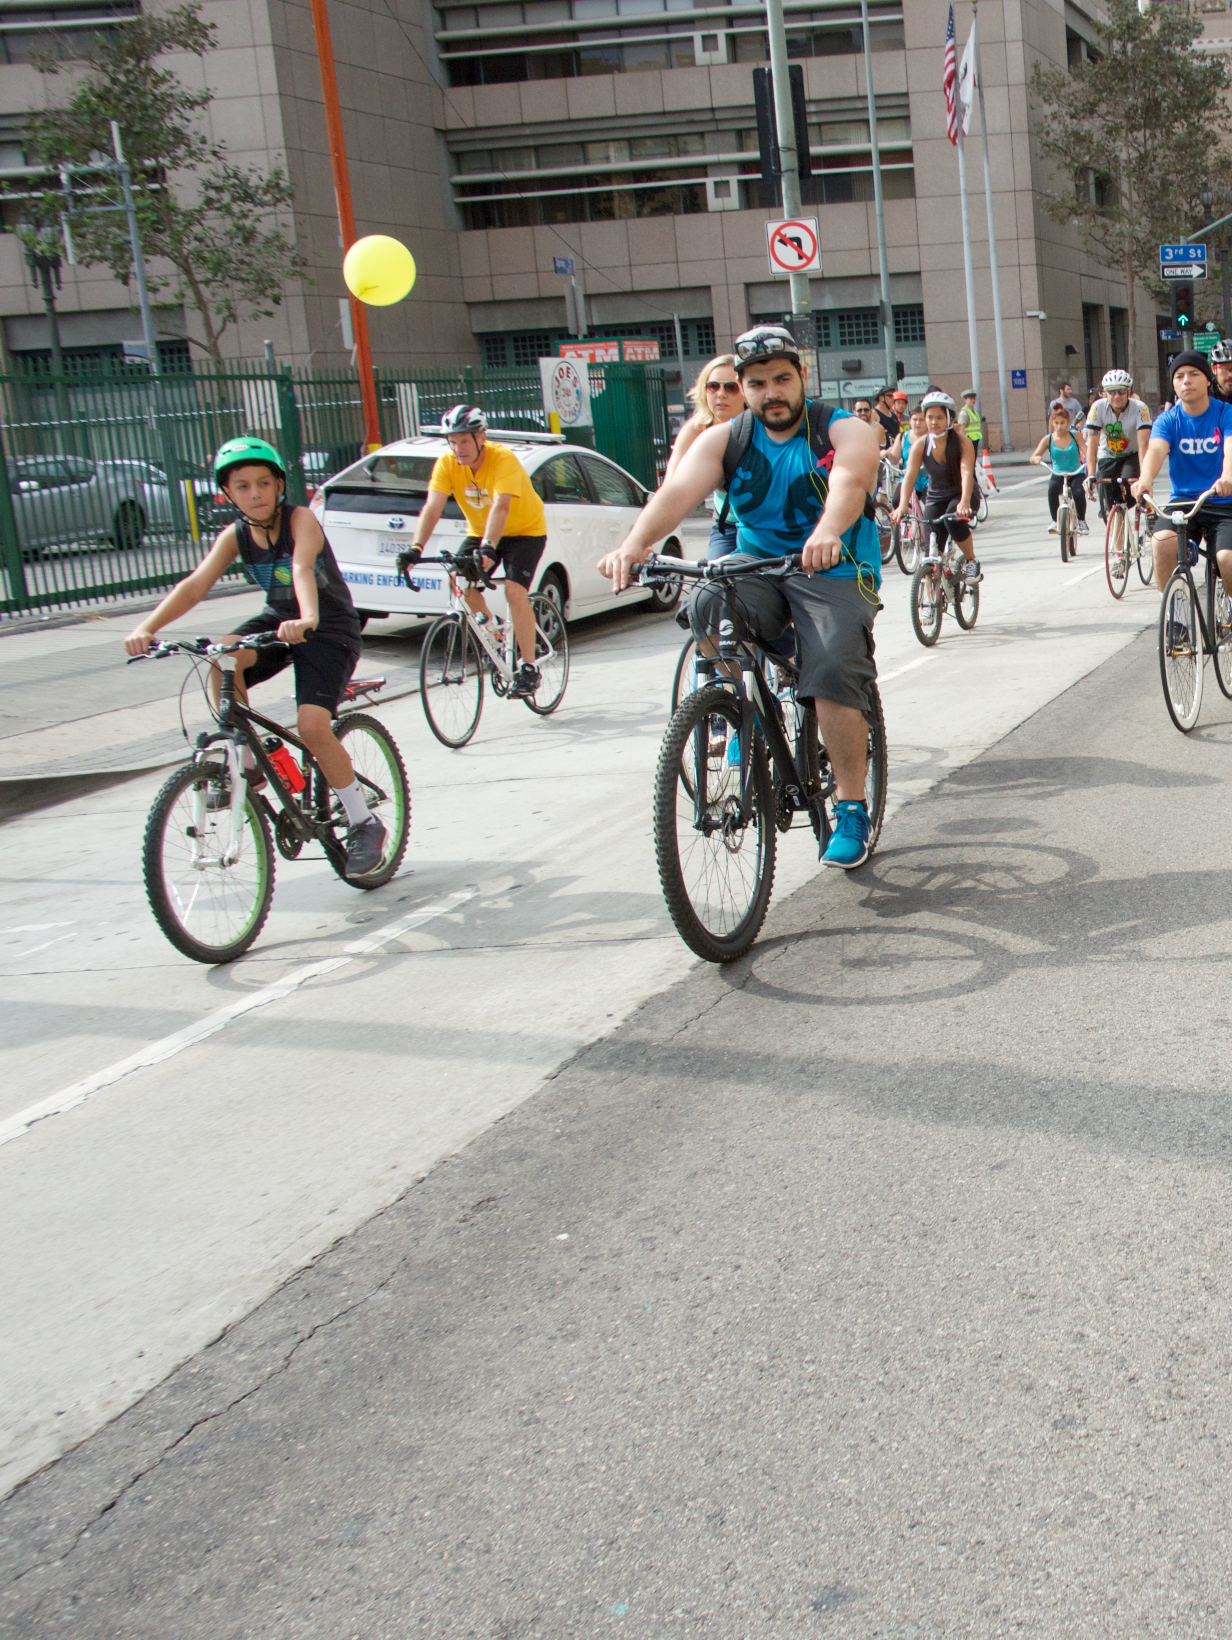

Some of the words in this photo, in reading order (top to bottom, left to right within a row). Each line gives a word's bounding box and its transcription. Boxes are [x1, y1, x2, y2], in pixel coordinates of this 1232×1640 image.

[1165, 247, 1183, 260] 3rd
[1189, 248, 1201, 258] St
[565, 348, 619, 363] ATM
[625, 347, 660, 360] ATM
[1179, 438, 1218, 455] arc
[340, 572, 374, 585] ARKING
